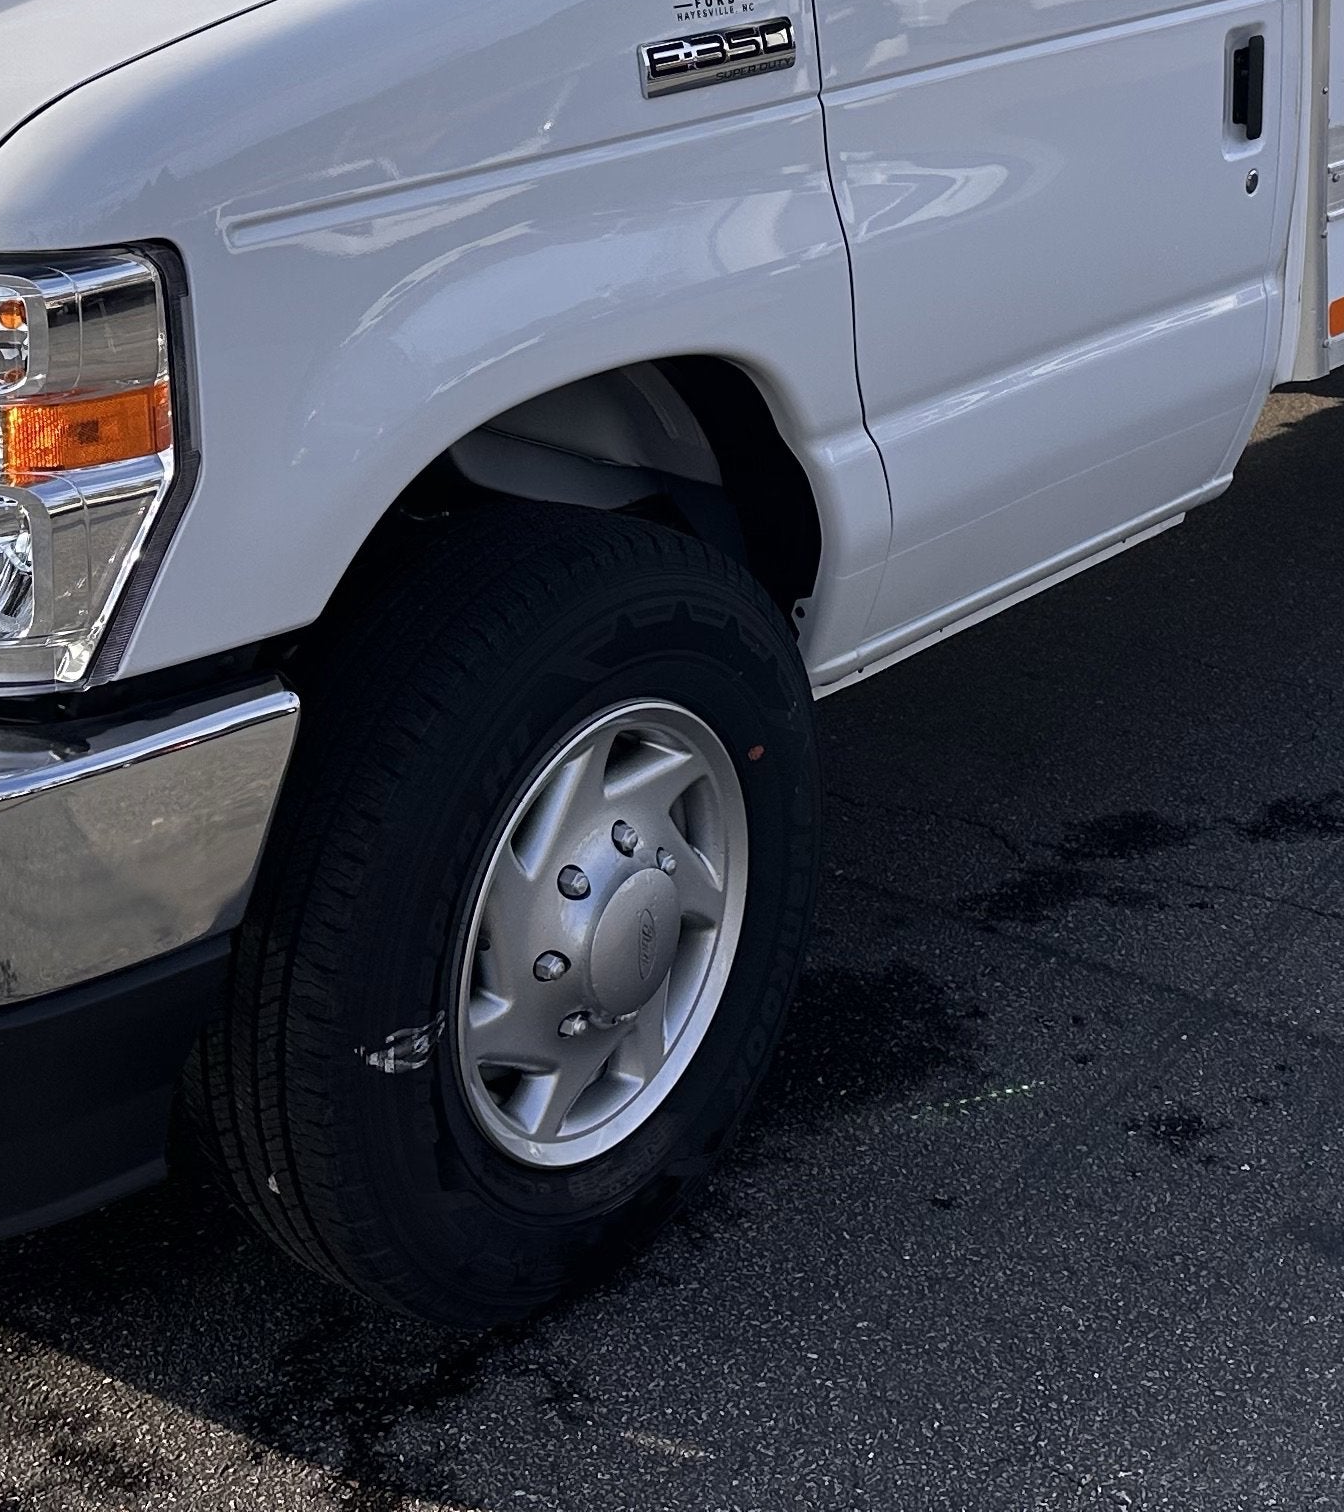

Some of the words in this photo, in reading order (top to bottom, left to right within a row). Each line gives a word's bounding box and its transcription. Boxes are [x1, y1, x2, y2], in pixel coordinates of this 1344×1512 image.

[743, 3, 755, 12] NC
[716, 65, 756, 81] SUPER
[759, 57, 792, 73] DUTY
